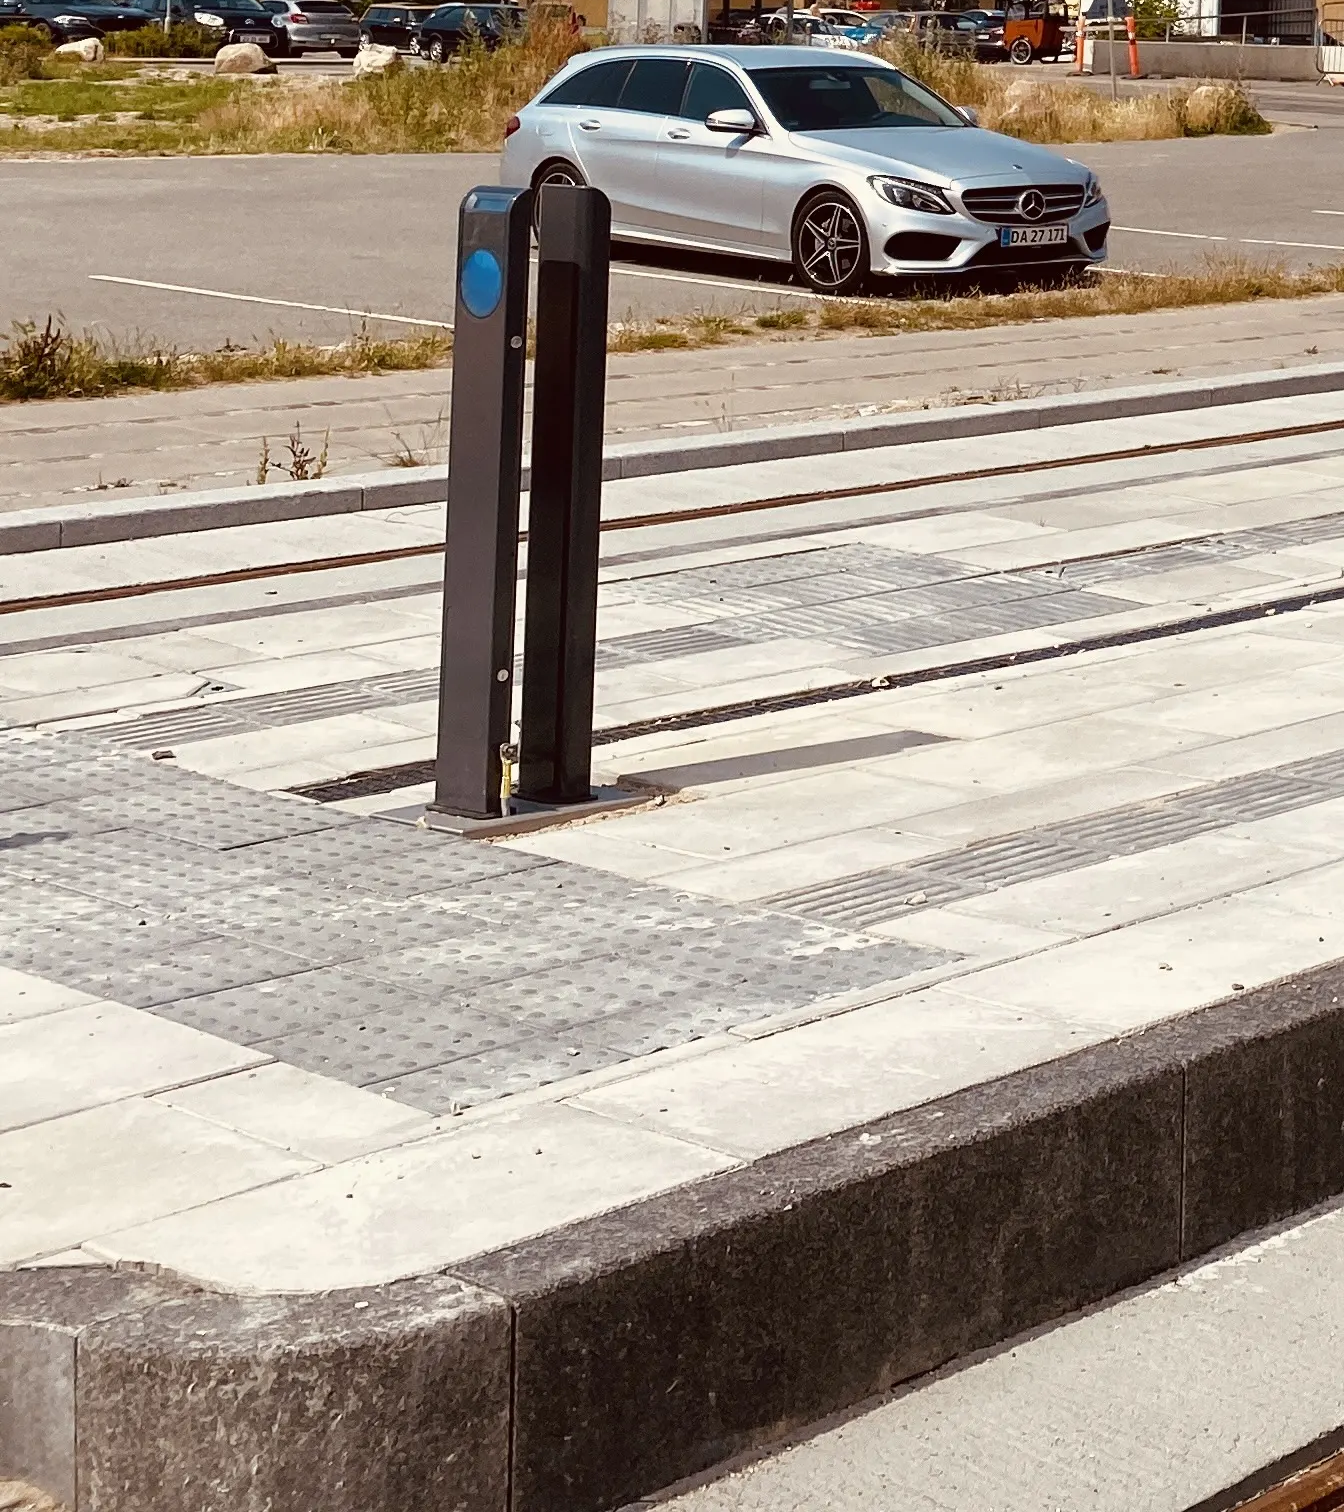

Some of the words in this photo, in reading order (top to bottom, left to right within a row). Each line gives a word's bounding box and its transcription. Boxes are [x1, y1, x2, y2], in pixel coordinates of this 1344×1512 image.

[1011, 230, 1028, 244] DA
[1030, 229, 1045, 243] 27
[1047, 228, 1065, 242] 171
